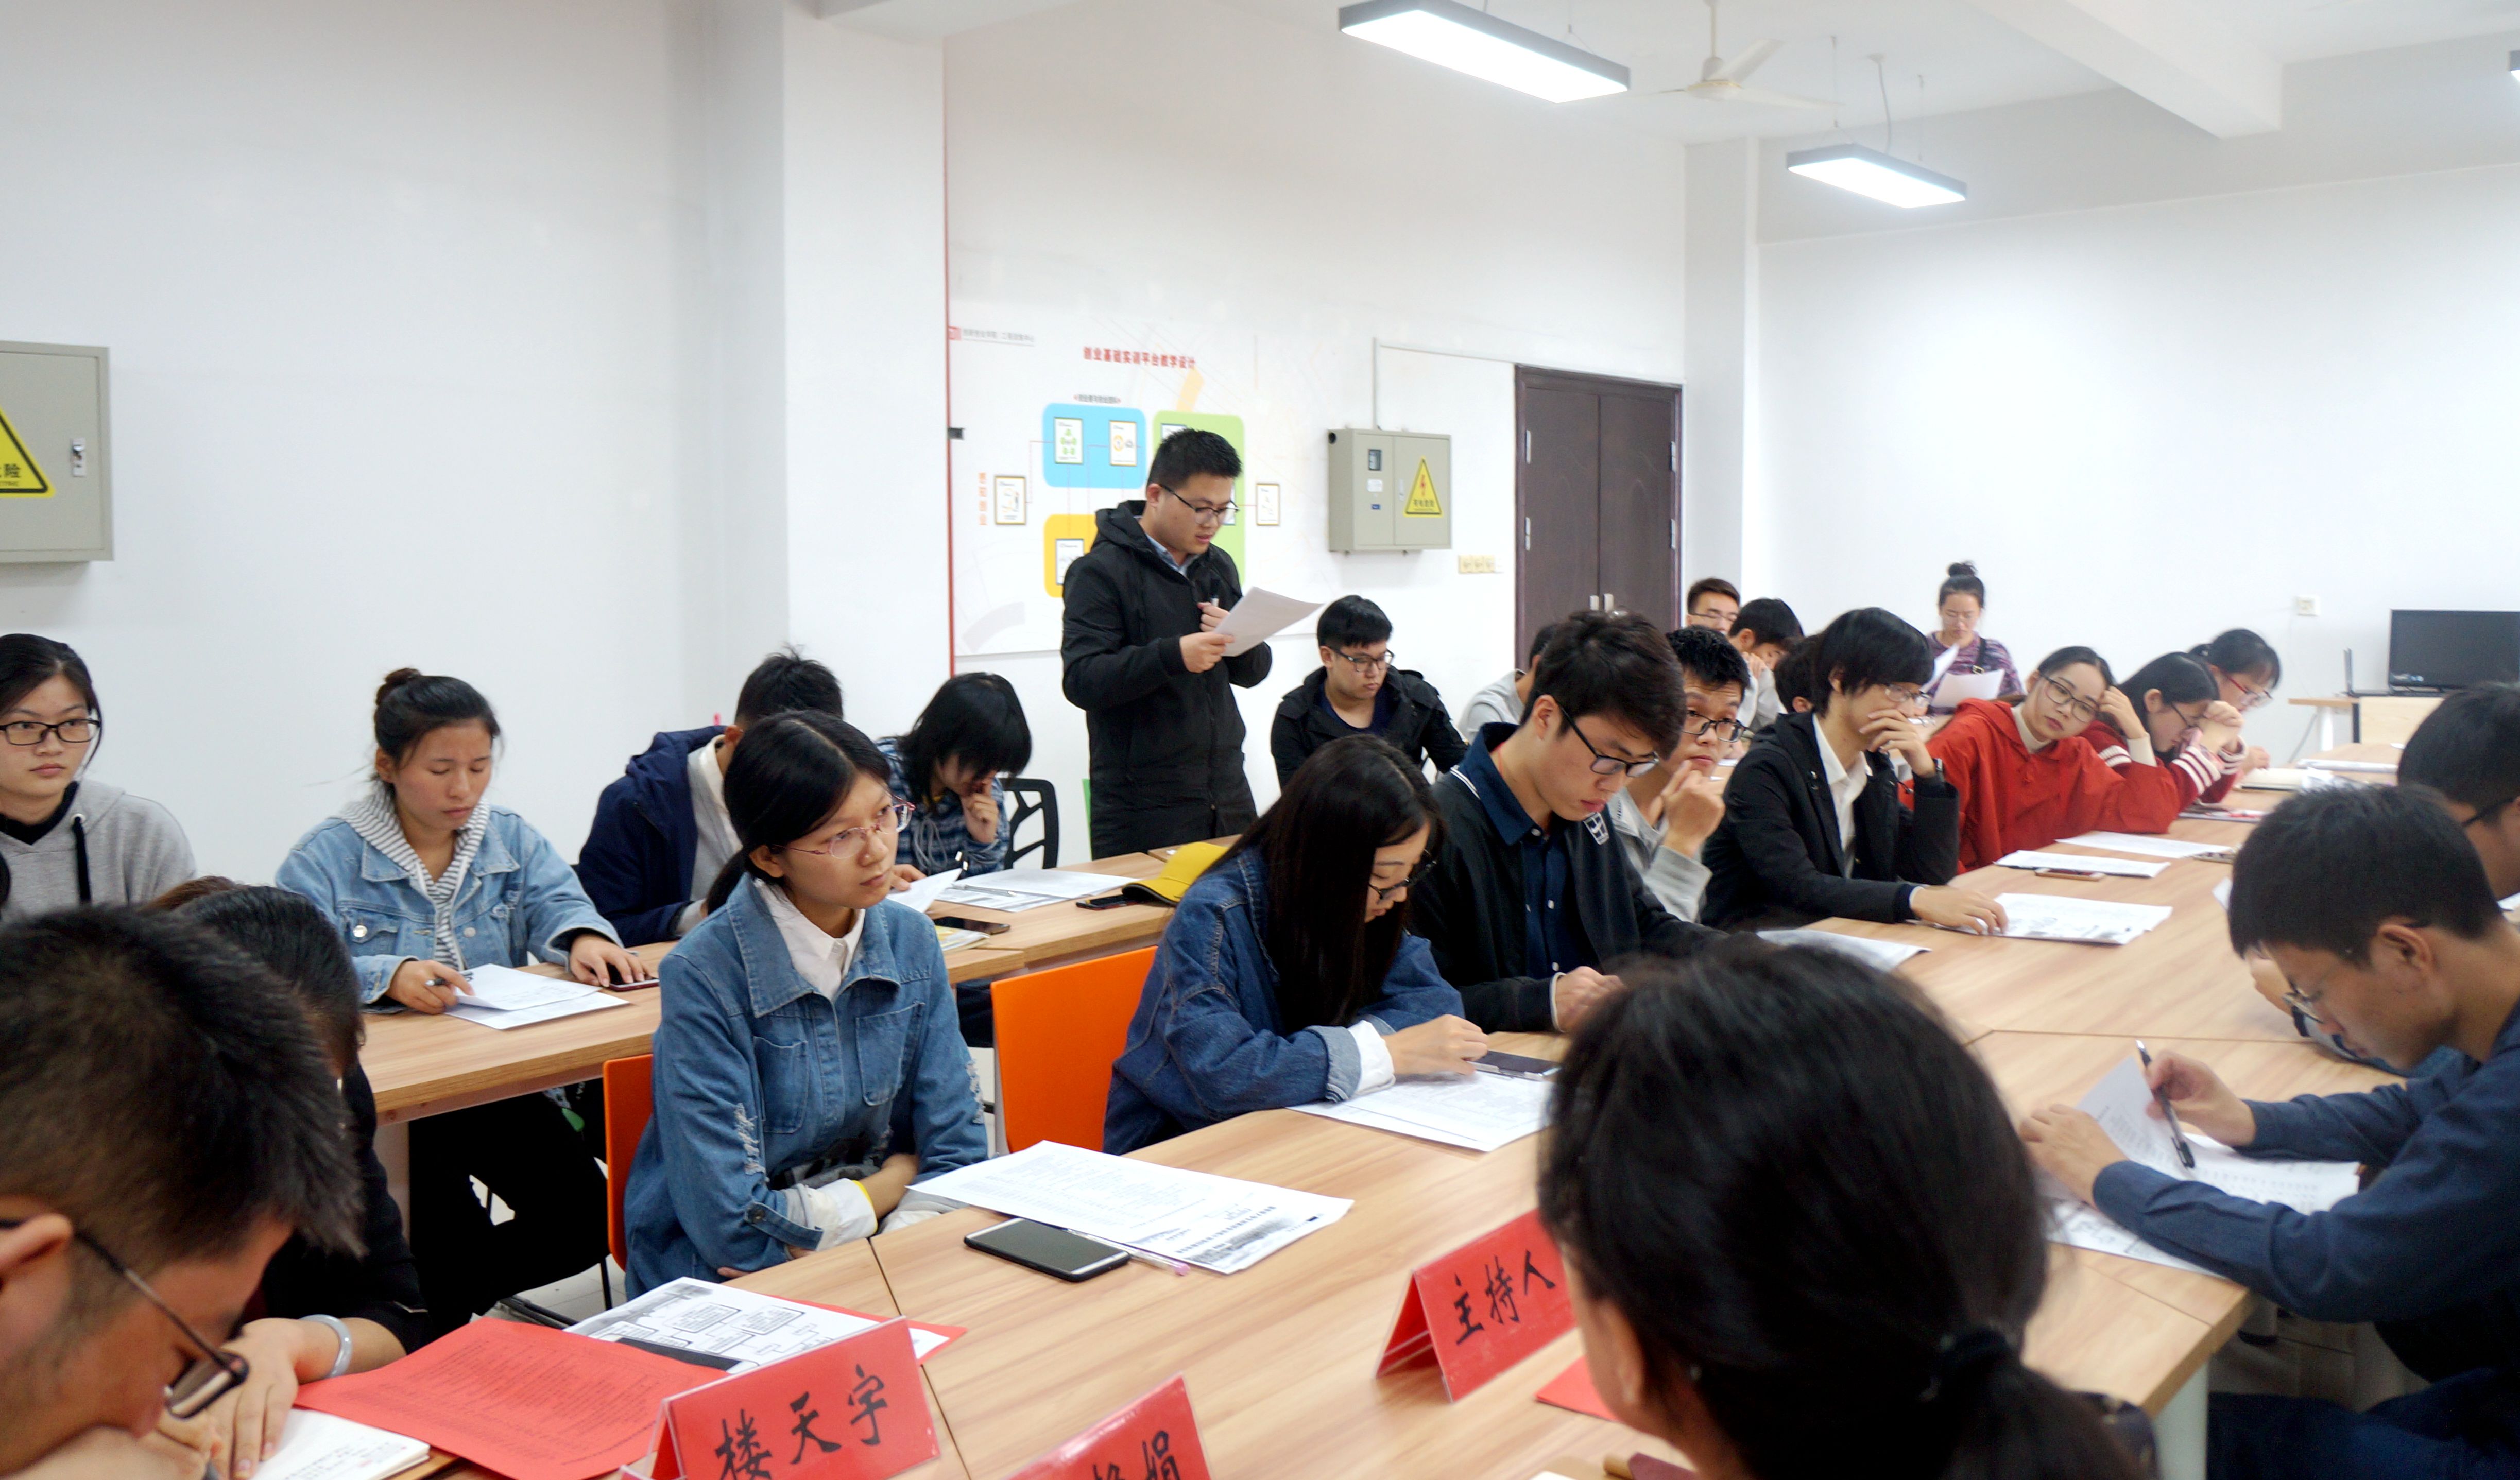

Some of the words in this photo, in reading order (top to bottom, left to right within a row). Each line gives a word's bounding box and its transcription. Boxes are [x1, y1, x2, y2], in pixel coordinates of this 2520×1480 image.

[0, 464, 21, 478] 险
[1454, 1250, 1556, 1346] 主持人
[715, 1364, 888, 1480] 楼天宇
[1092, 1430, 1181, 1480] 娟
